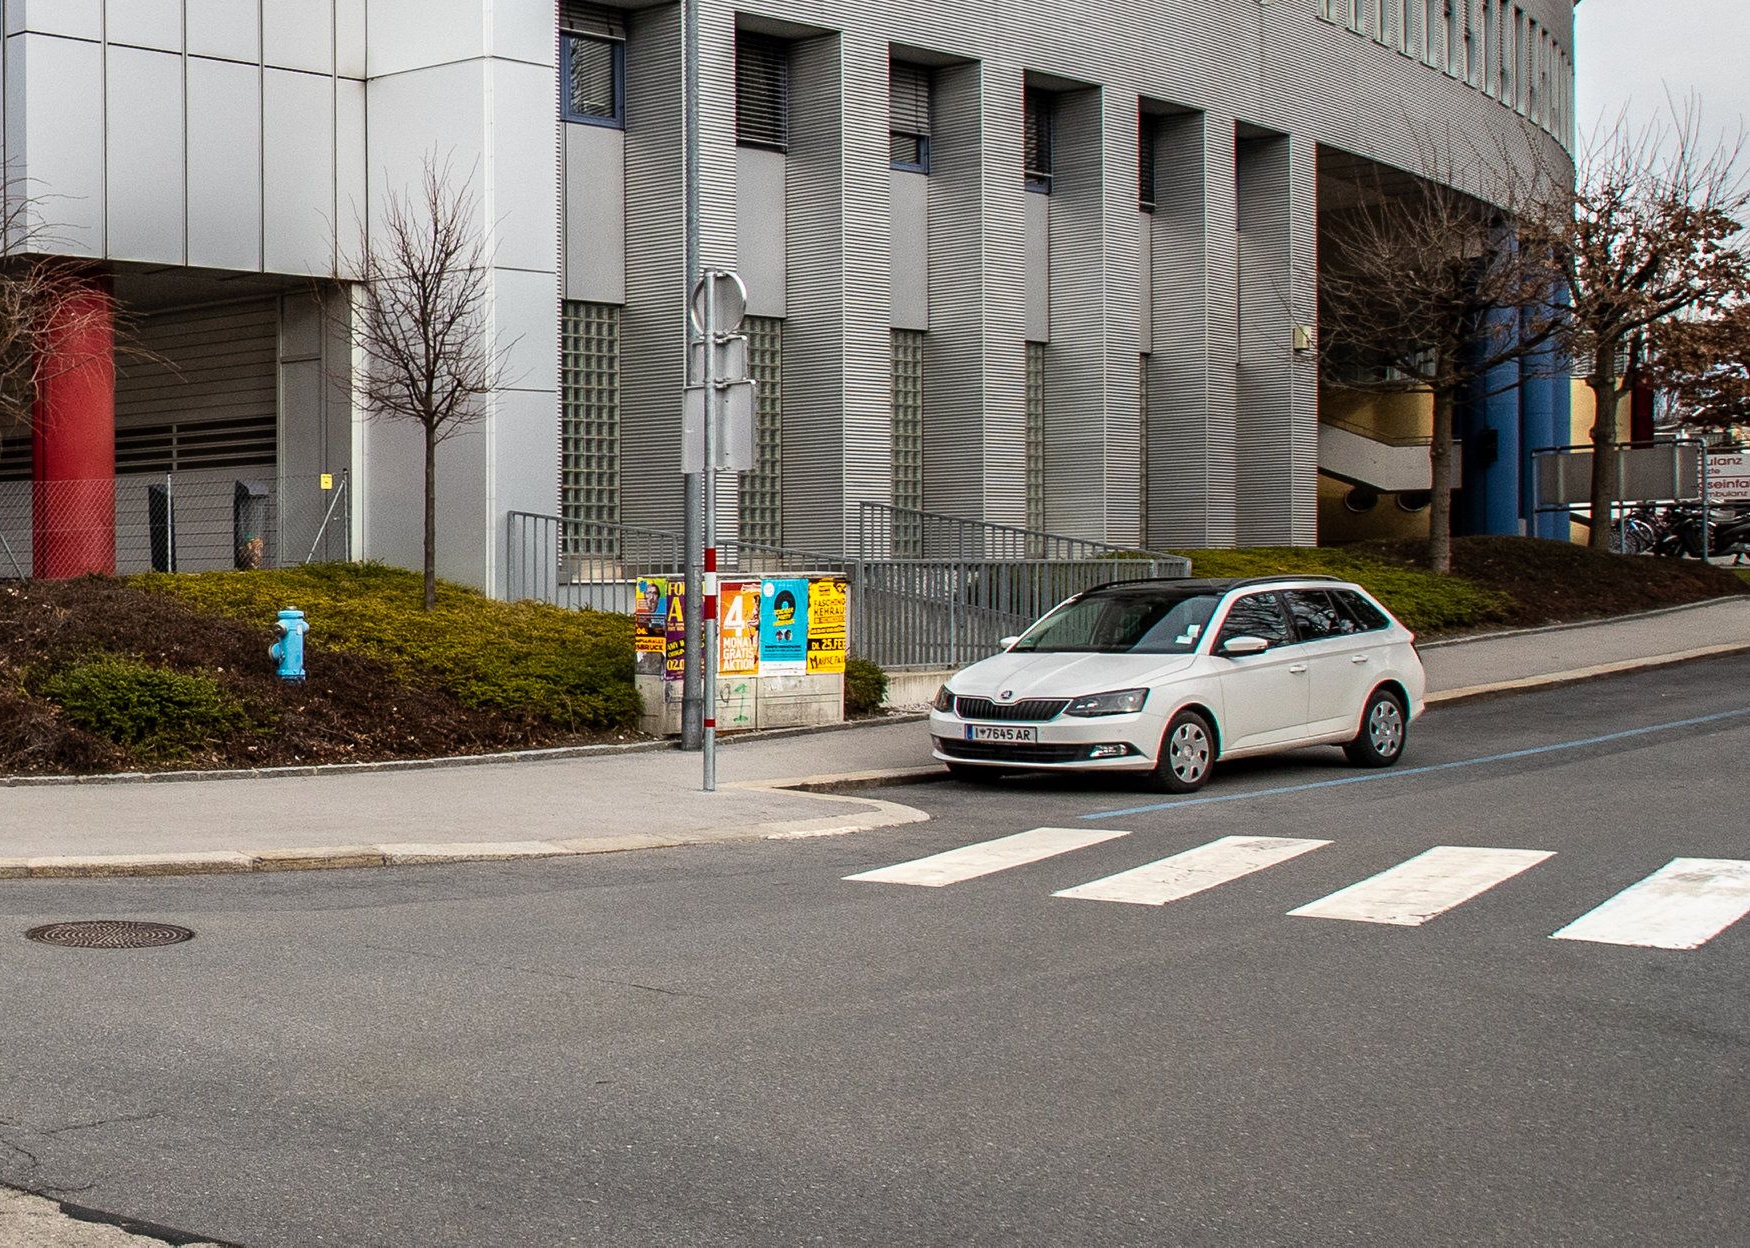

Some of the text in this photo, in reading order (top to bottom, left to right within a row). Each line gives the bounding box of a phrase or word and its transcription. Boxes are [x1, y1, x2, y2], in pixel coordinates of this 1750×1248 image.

[1697, 455, 1743, 466] ulanz
[723, 595, 746, 638] 4
[723, 636, 758, 649] MONATE
[723, 647, 755, 660] GRATIS
[723, 658, 755, 671] AKTION
[986, 727, 1014, 740] 7645
[1016, 729, 1031, 741] AR
